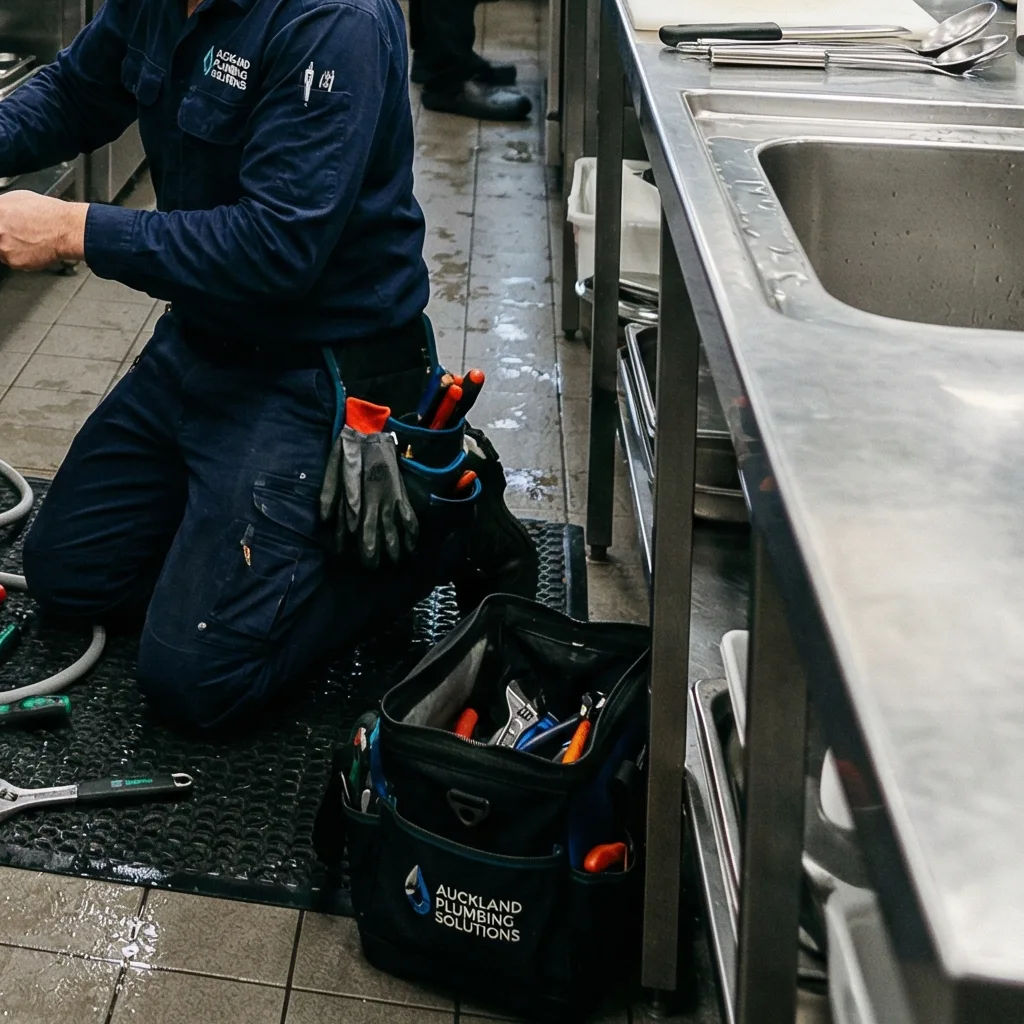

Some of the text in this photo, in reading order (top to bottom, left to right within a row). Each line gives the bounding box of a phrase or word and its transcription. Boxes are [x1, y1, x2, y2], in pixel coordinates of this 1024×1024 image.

[436, 884, 522, 914] AUCKLAND
[436, 897, 514, 927] PLUMBING
[435, 911, 520, 942] SOLUTIONS
